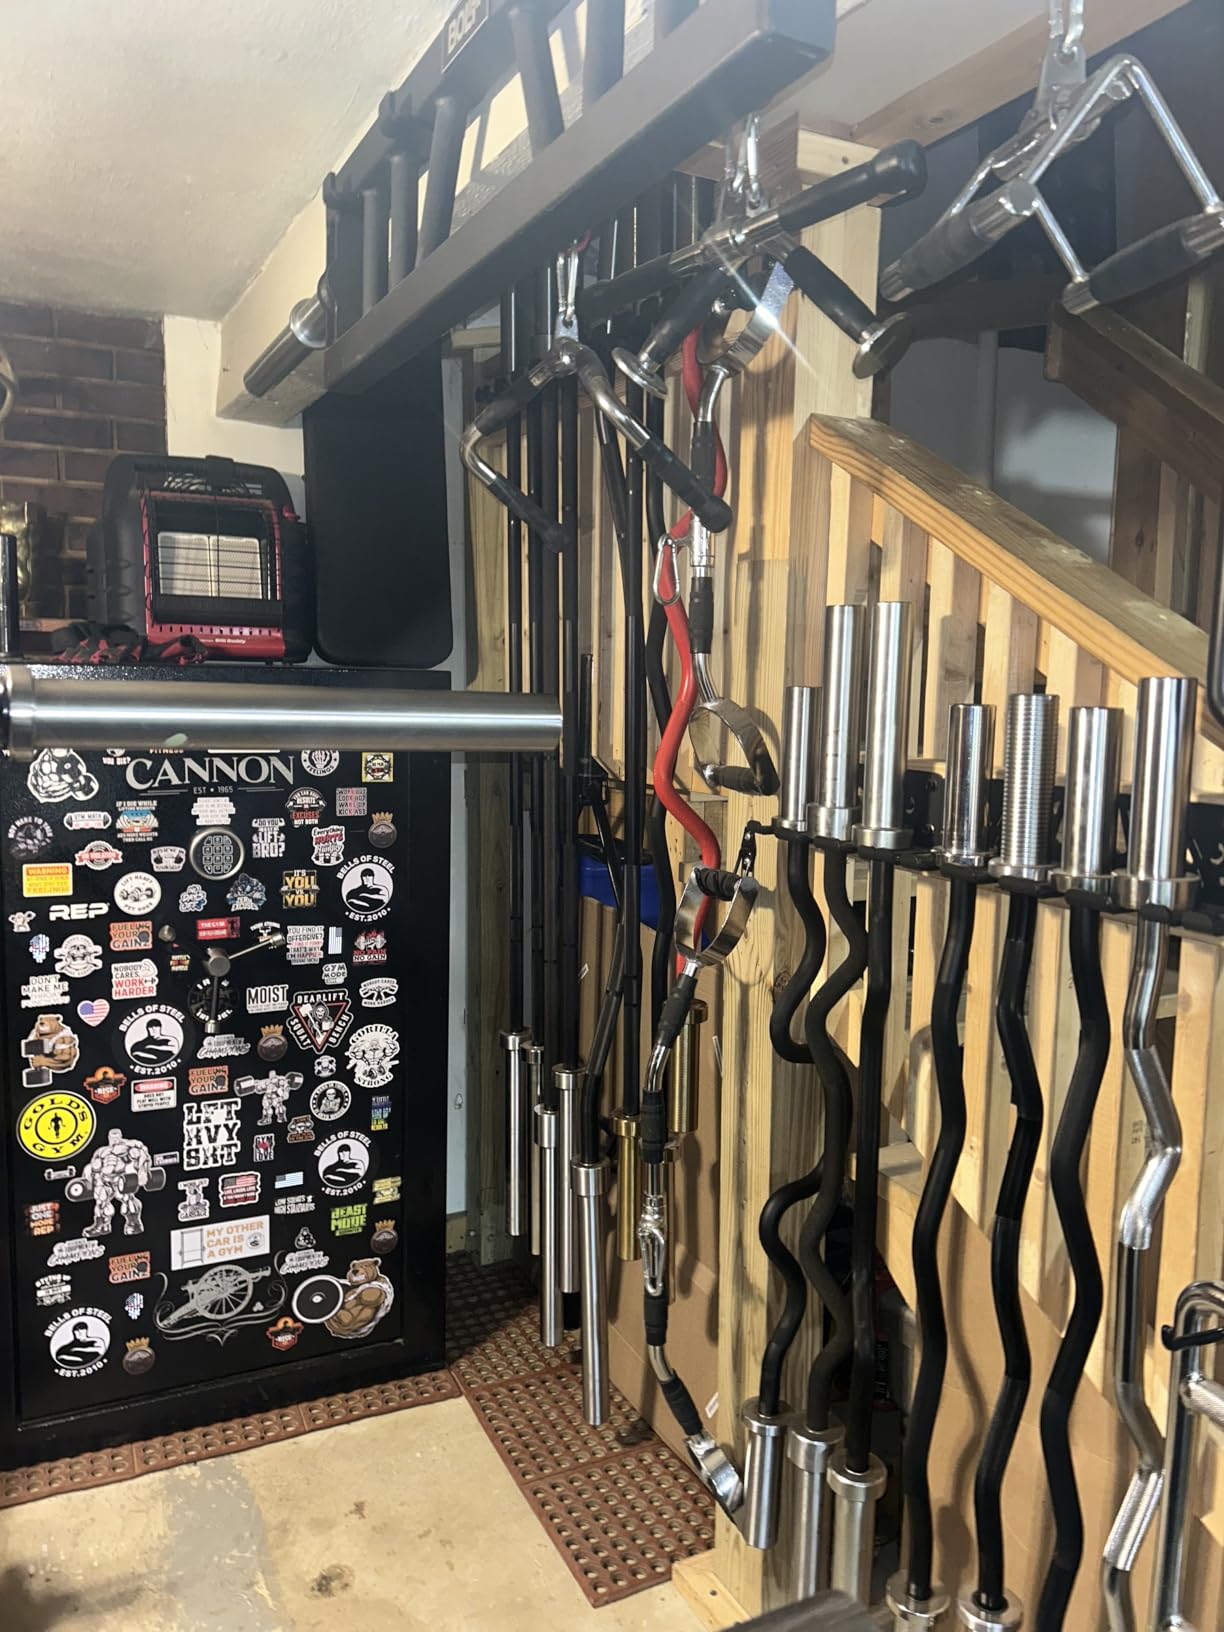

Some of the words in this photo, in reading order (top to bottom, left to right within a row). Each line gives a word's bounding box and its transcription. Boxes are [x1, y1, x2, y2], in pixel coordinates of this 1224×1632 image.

[126, 755, 295, 790] CANNON
[306, 764, 335, 775] FEELINGS
[193, 786, 206, 795] EST
[217, 785, 234, 794] 1965
[292, 811, 320, 819] EXCUSES
[258, 831, 279, 843] LIFT
[313, 828, 344, 836] Everything
[252, 842, 285, 858] BRO?
[336, 857, 360, 879] BELLS
[360, 855, 372, 863] OF
[372, 855, 396, 874] STEEL
[121, 876, 133, 887] LIFT
[286, 876, 315, 889] YOU
[286, 894, 315, 908] YOU
[49, 903, 109, 921] REP
[124, 904, 135, 912] PET
[348, 909, 388, 922] EST.2010
[113, 930, 138, 938] YOUR
[287, 933, 323, 941] OFFENSIVE?
[31, 976, 59, 985] DON'T
[115, 979, 144, 988] WORK
[23, 985, 51, 994] MAKE
[115, 986, 155, 997] HARDER
[248, 985, 287, 1005] MOIST
[297, 992, 345, 1004] DEADLIFT
[118, 1007, 145, 1033] BELLS
[145, 1004, 159, 1013] OF
[159, 1004, 186, 1024] STEEL
[290, 1018, 312, 1046] SQUAT
[328, 1013, 351, 1044] BENCH
[351, 1025, 398, 1044] GORILLA
[133, 1062, 178, 1076] EST.2010
[191, 1076, 216, 1084] YOUR
[358, 1074, 392, 1086] STRONG
[24, 1098, 88, 1130] GOLD'S
[186, 1122, 238, 1147] HVY
[32, 1133, 84, 1153] GYM
[313, 1134, 338, 1157] BELLS
[337, 1131, 349, 1139] OF
[349, 1130, 372, 1147] STEEL
[324, 1182, 363, 1196] EST.2010
[31, 1211, 54, 1220] ONE
[331, 1203, 368, 1219] BEAST
[207, 1228, 224, 1237] MY
[226, 1221, 264, 1233] OTHER
[331, 1215, 367, 1231] MODE
[33, 1226, 54, 1235] REP
[207, 1238, 230, 1247] CAR
[233, 1234, 244, 1243] IS
[207, 1250, 215, 1258] A
[218, 1245, 243, 1256] GYM
[112, 1263, 137, 1272] YOUR
[44, 1312, 71, 1338] BELLS
[71, 1307, 85, 1317] OF
[86, 1307, 113, 1325] STEEL
[58, 1362, 104, 1378] EST.2010
